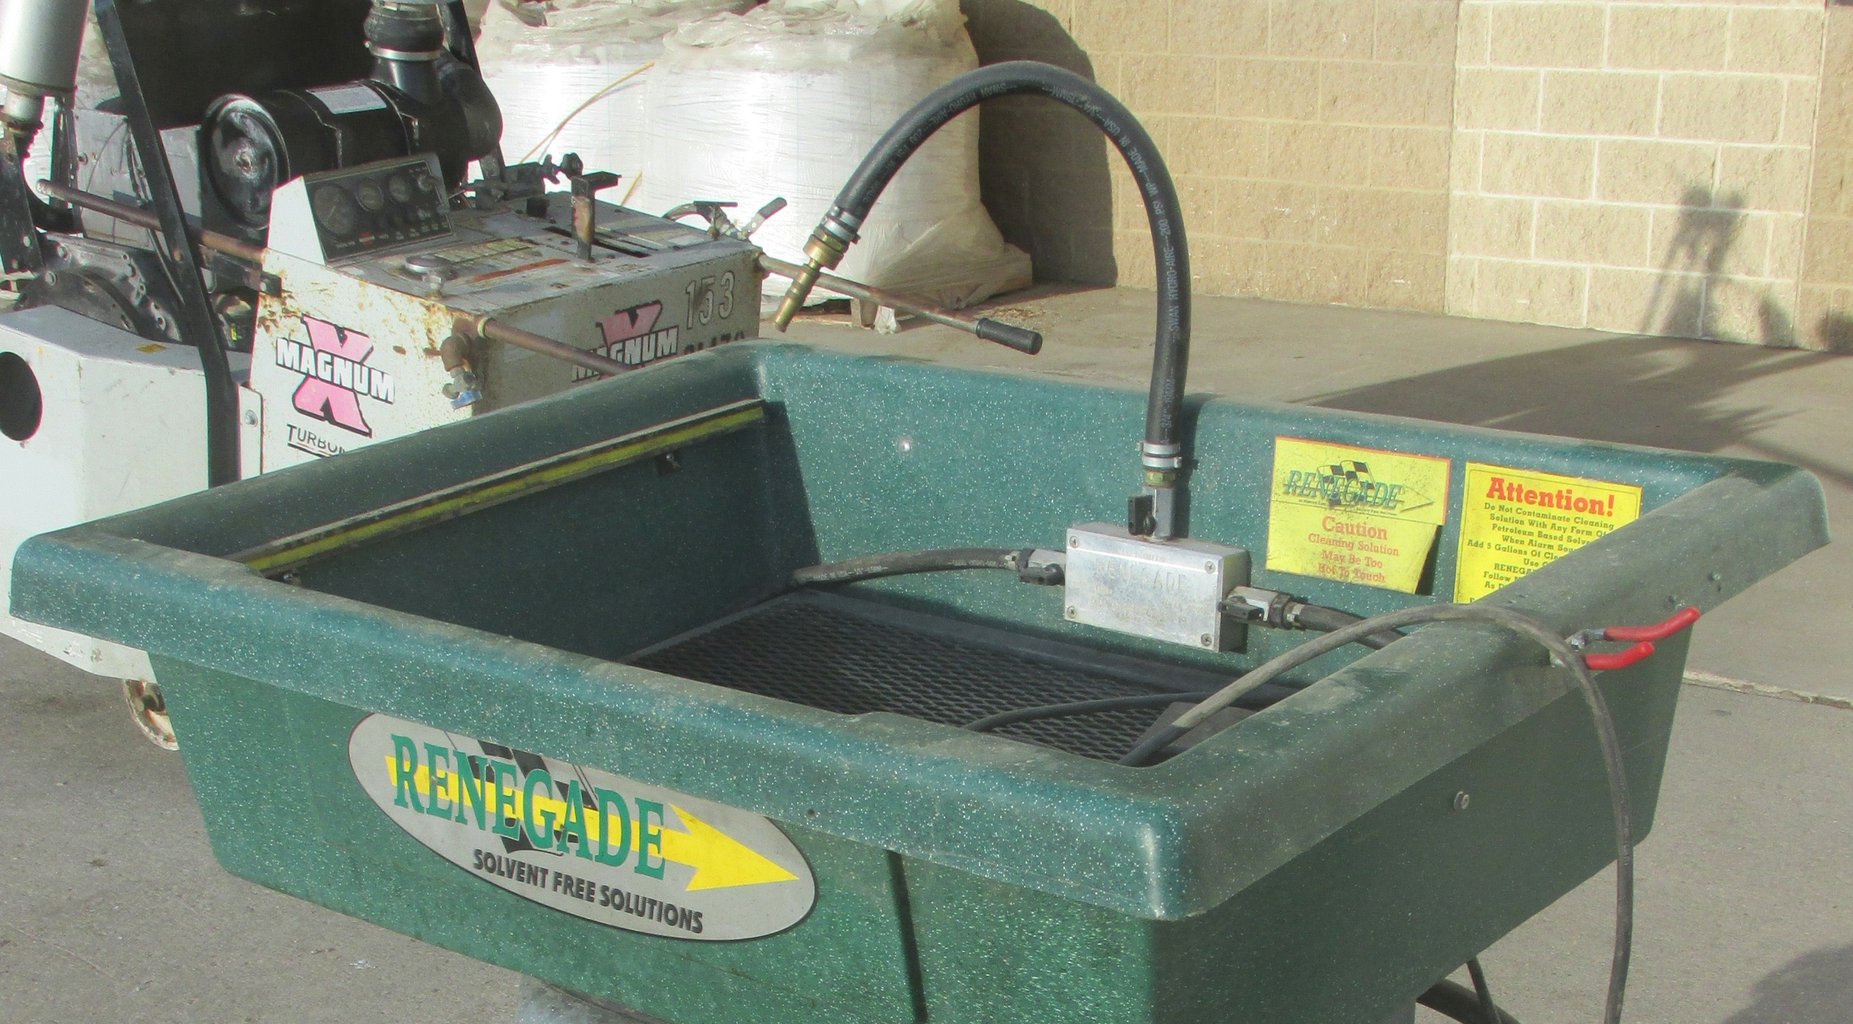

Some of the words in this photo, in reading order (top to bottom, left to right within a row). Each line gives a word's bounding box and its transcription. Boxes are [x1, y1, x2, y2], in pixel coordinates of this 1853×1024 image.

[685, 270, 736, 330] 153
[1168, 305, 1181, 332] SWAN
[276, 337, 396, 404] MAGNUM
[1283, 469, 1405, 511] RENEGADE
[1486, 477, 1615, 517] Attention!
[1321, 515, 1388, 540] Caution
[1484, 502, 1496, 511] Do
[1498, 504, 1513, 514] Not
[1515, 507, 1571, 523] Contaminate
[1573, 516, 1615, 531] Cleaning
[1490, 513, 1525, 526] Solution
[1528, 518, 1548, 529] With
[1550, 521, 1568, 534] Any
[1571, 526, 1593, 537] Form
[1308, 533, 1355, 551] Cleaning
[1358, 540, 1400, 556] Solution
[1492, 523, 1535, 537] Petroleum
[1537, 530, 1564, 542] Based
[1502, 535, 1525, 546] When
[1527, 539, 1554, 551] Alarm
[1321, 550, 1345, 563] May
[1349, 554, 1361, 565] Be
[1365, 557, 1383, 569] Too
[1467, 539, 1484, 549] Add
[1487, 542, 1492, 550] 5
[1494, 544, 1528, 556] Gallons
[1530, 550, 1541, 558] Of
[1318, 563, 1336, 575] Hot
[1340, 567, 1350, 578] To
[1353, 568, 1386, 583] Touch
[1523, 558, 1539, 567] Use
[1483, 571, 1511, 582] Follow
[1484, 581, 1496, 589] As
[391, 733, 665, 880] RENEGADE
[473, 848, 549, 889] SOLVENT
[552, 871, 596, 902] FREE
[599, 885, 704, 934] SOLUTIONS
